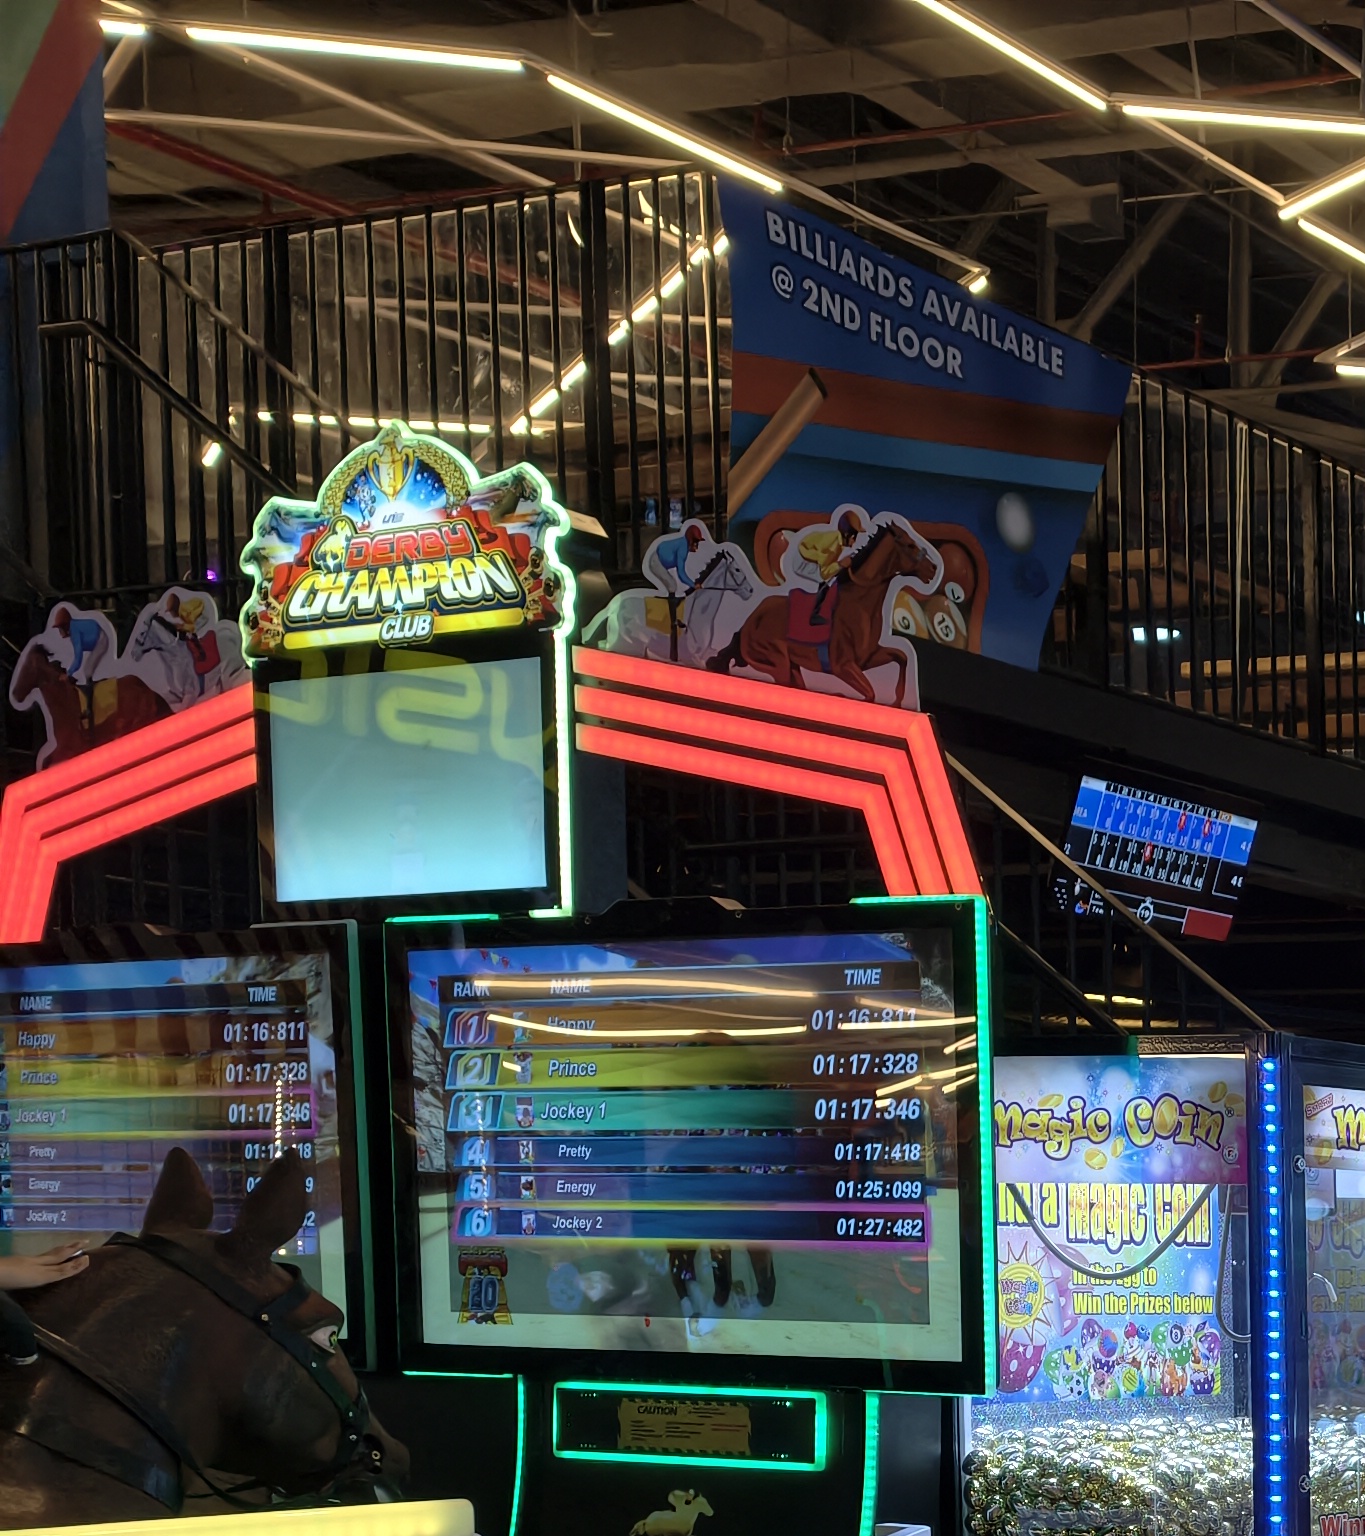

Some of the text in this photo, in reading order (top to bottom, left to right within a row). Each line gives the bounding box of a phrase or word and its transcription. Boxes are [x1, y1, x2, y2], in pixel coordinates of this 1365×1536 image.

[765, 210, 1064, 377] BILLIARDS AVAILABLE
[771, 264, 963, 379] @ 2ND FLOOR
[345, 523, 471, 568] DERBY
[286, 553, 519, 619] CHAMPION
[380, 615, 433, 641] CLUB
[453, 968, 882, 998] RANK NAME TIME
[19, 986, 278, 1011] NAME TIME
[810, 1009, 918, 1031] 01:16:811
[18, 1021, 306, 1049] Happy 01:16:811
[20, 1062, 307, 1085] Prince 01:17:328
[548, 1053, 919, 1077] Prince 01:17:328
[15, 1109, 68, 1125] Jockey 1
[540, 1098, 921, 1122] Jockey 1 01:17:346
[29, 1146, 57, 1159] Pretty
[558, 1143, 921, 1162] Pretty 01:17:418
[28, 1178, 61, 1192] Energy
[556, 1180, 922, 1200] Energy 01:25:099
[26, 1210, 59, 1224] Jockey
[471, 1208, 923, 1237] 6 Jockey 2 01:27:482
[1143, 1266, 1158, 1286] to
[1072, 1292, 1213, 1315] Win the Prizes below
[637, 1405, 678, 1416] CAUTION
